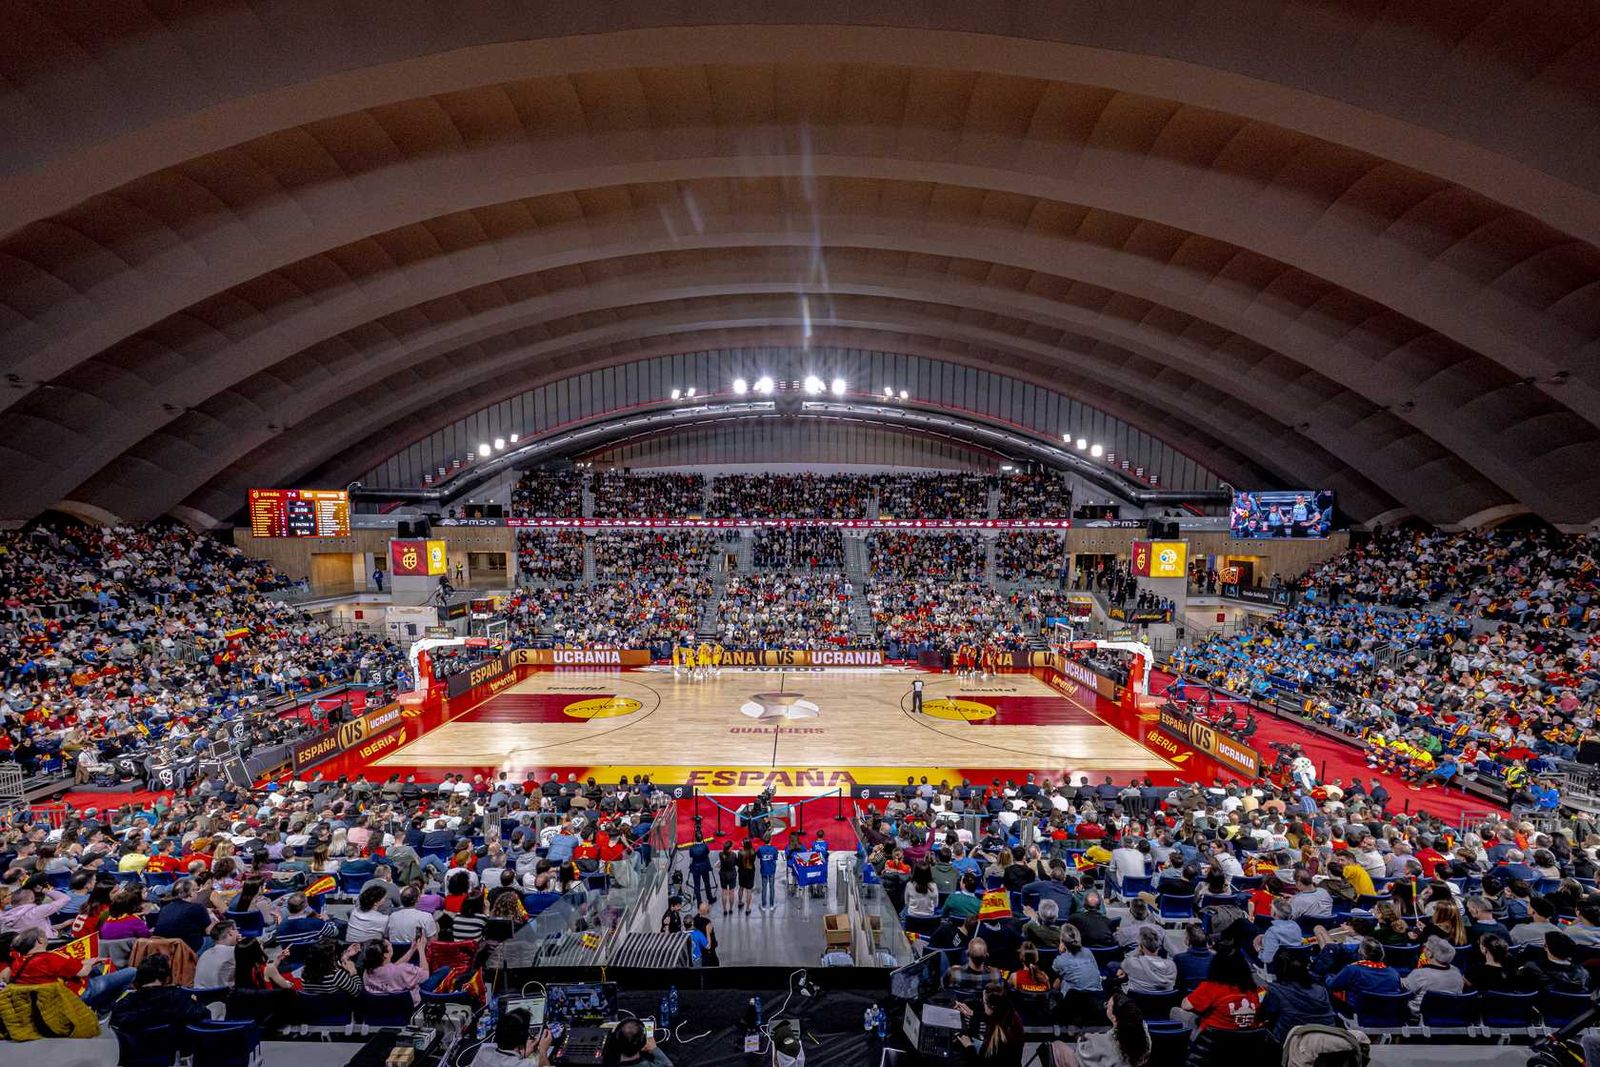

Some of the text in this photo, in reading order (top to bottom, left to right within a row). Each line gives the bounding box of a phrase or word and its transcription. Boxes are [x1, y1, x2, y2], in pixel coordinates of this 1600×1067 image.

[553, 650, 621, 664] UCRANIA
[776, 650, 794, 665] VS
[811, 651, 882, 665] UCRANIA
[470, 658, 503, 687] ESPAÑA
[1043, 652, 1098, 689] VS UCRANIA
[298, 709, 399, 764] ESPAÑA VS UCRANIA
[359, 734, 397, 759] IBERIA
[1147, 730, 1179, 754] IBERIA
[1161, 713, 1255, 769] ESPAÑA VS UCRANIA
[686, 768, 857, 787] ESPAÑA
